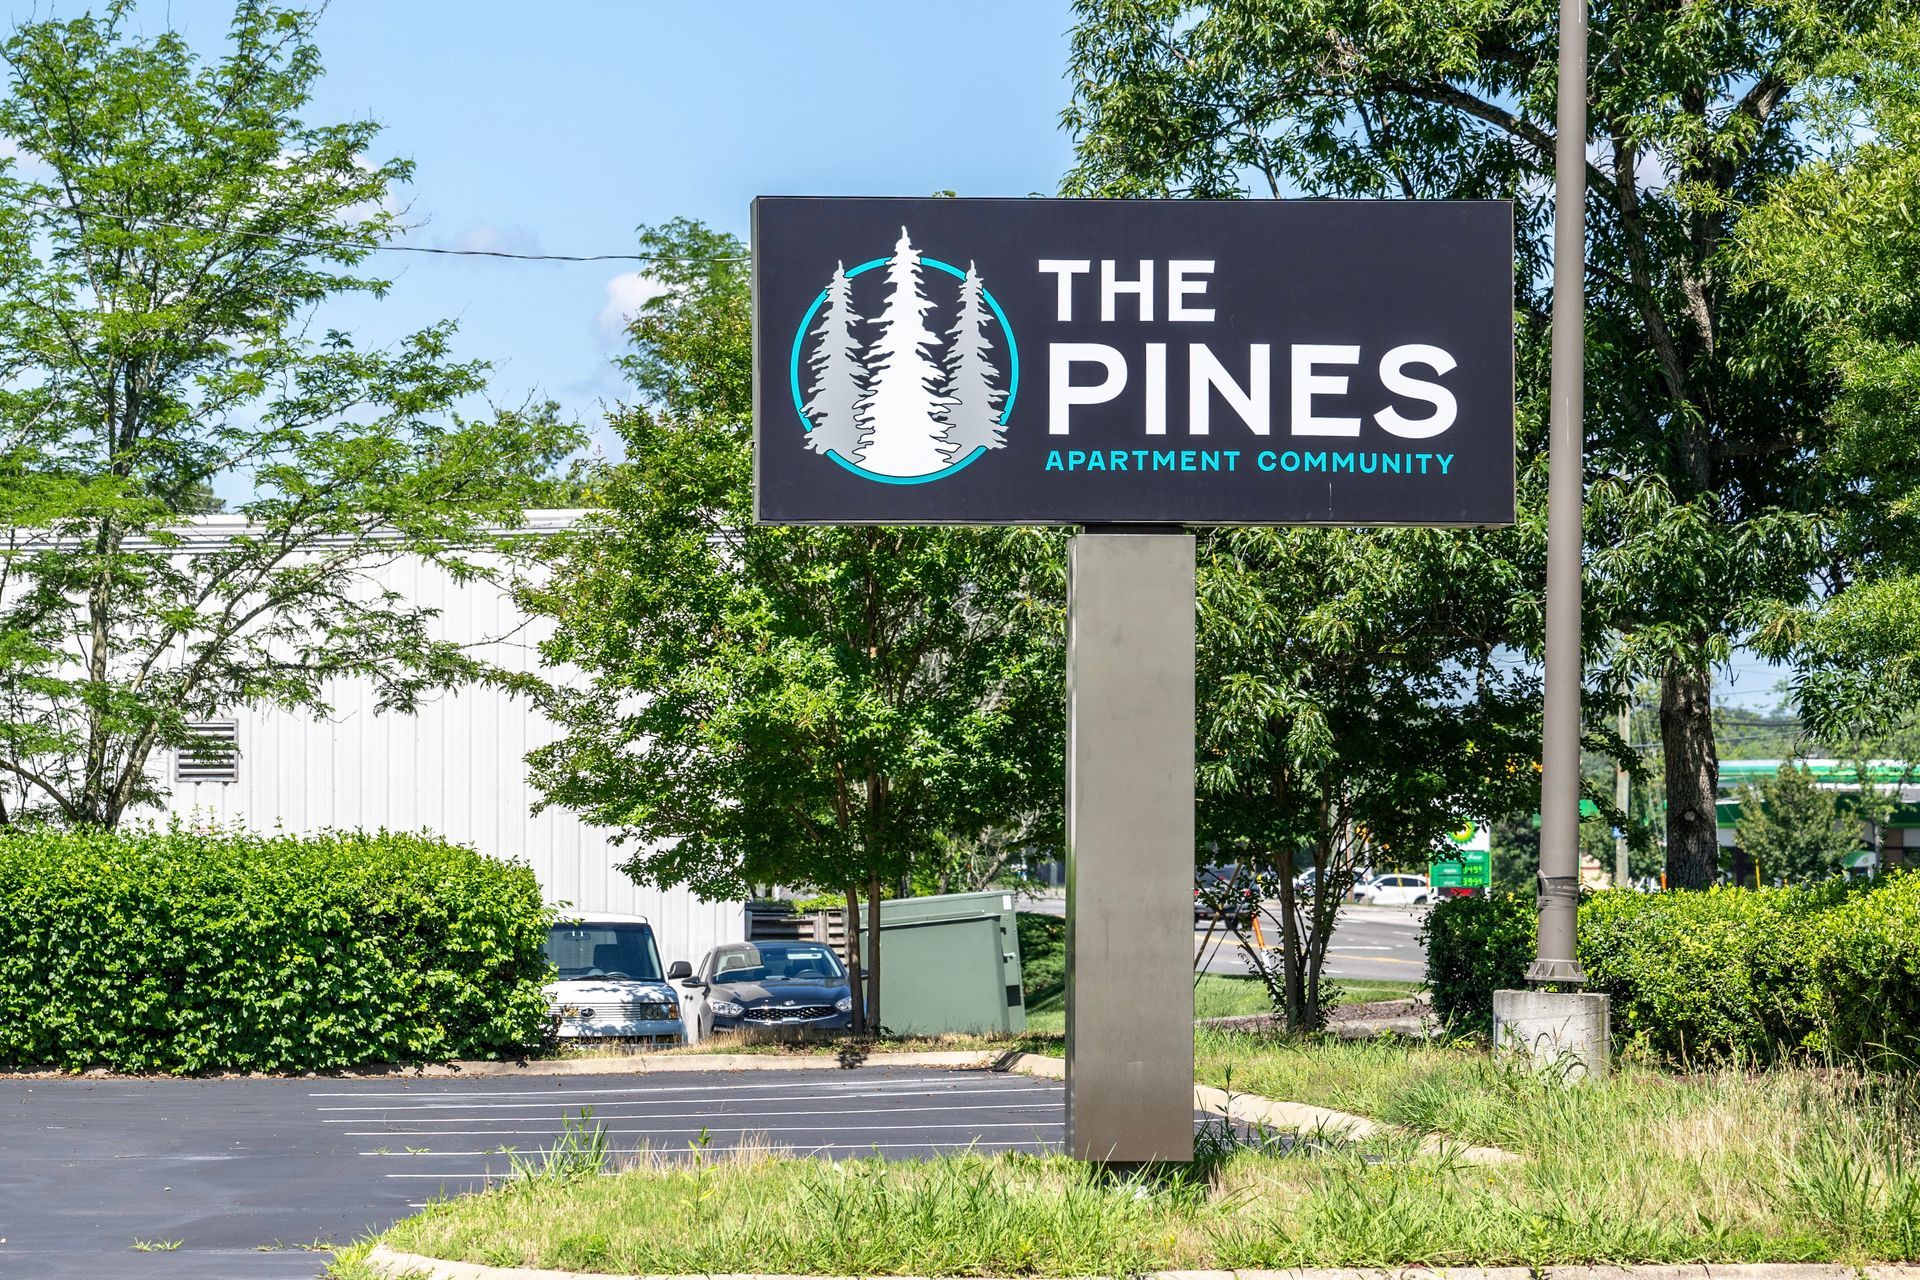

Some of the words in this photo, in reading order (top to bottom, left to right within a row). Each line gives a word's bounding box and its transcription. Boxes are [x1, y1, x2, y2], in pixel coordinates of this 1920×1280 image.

[1038, 258, 1216, 321] THE
[1048, 342, 1458, 440] PINES
[1044, 450, 1241, 472] APARTMENT
[1257, 450, 1455, 475] COMMUNITY
